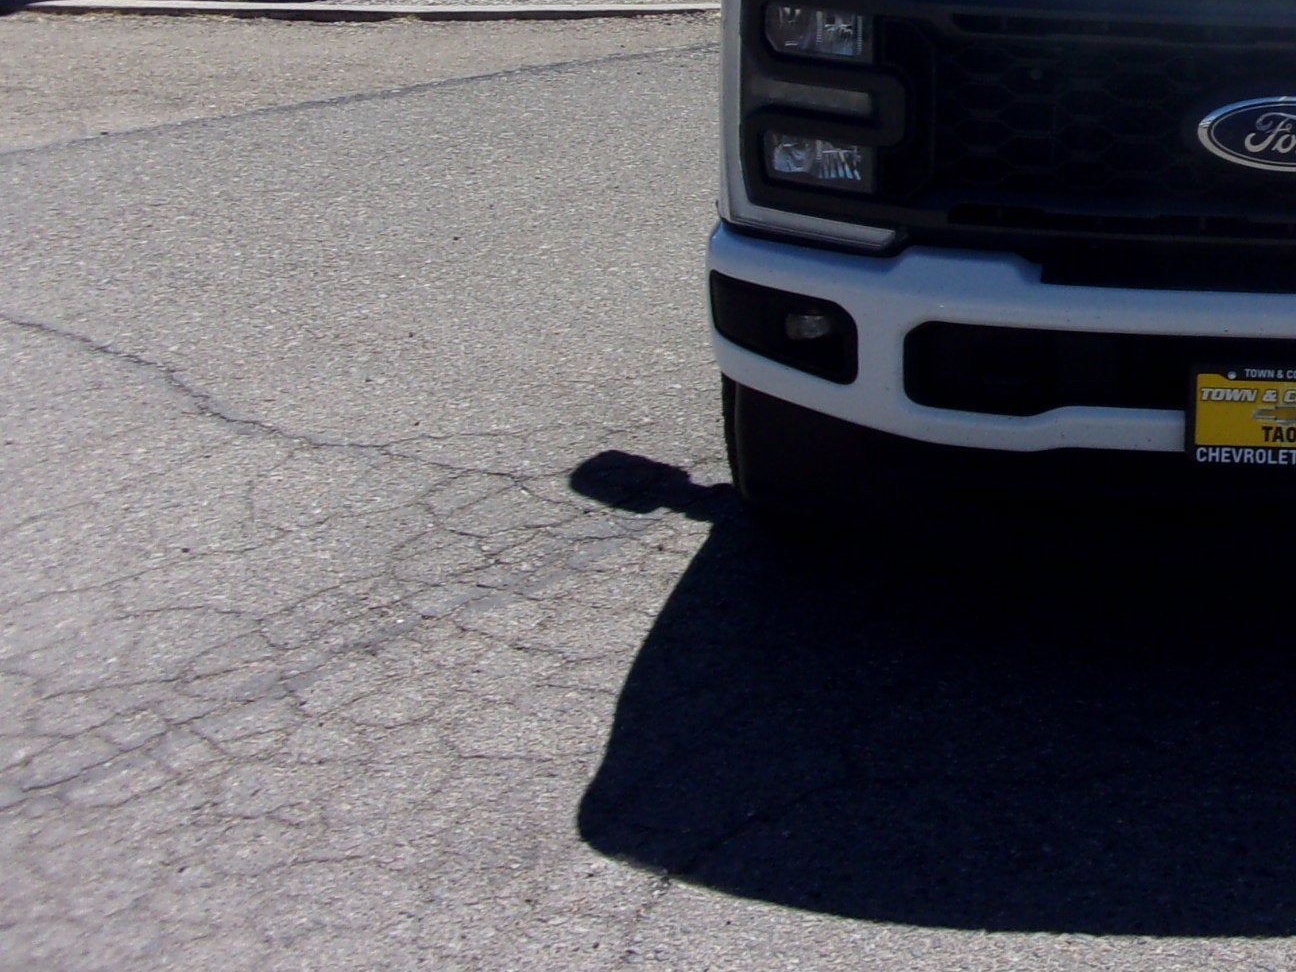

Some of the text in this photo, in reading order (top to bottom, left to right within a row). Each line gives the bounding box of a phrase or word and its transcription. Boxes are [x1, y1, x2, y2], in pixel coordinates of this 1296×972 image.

[1244, 368, 1275, 378] TOWN
[1276, 369, 1284, 379] &
[1201, 388, 1257, 402] TOWN
[1262, 389, 1278, 402] &
